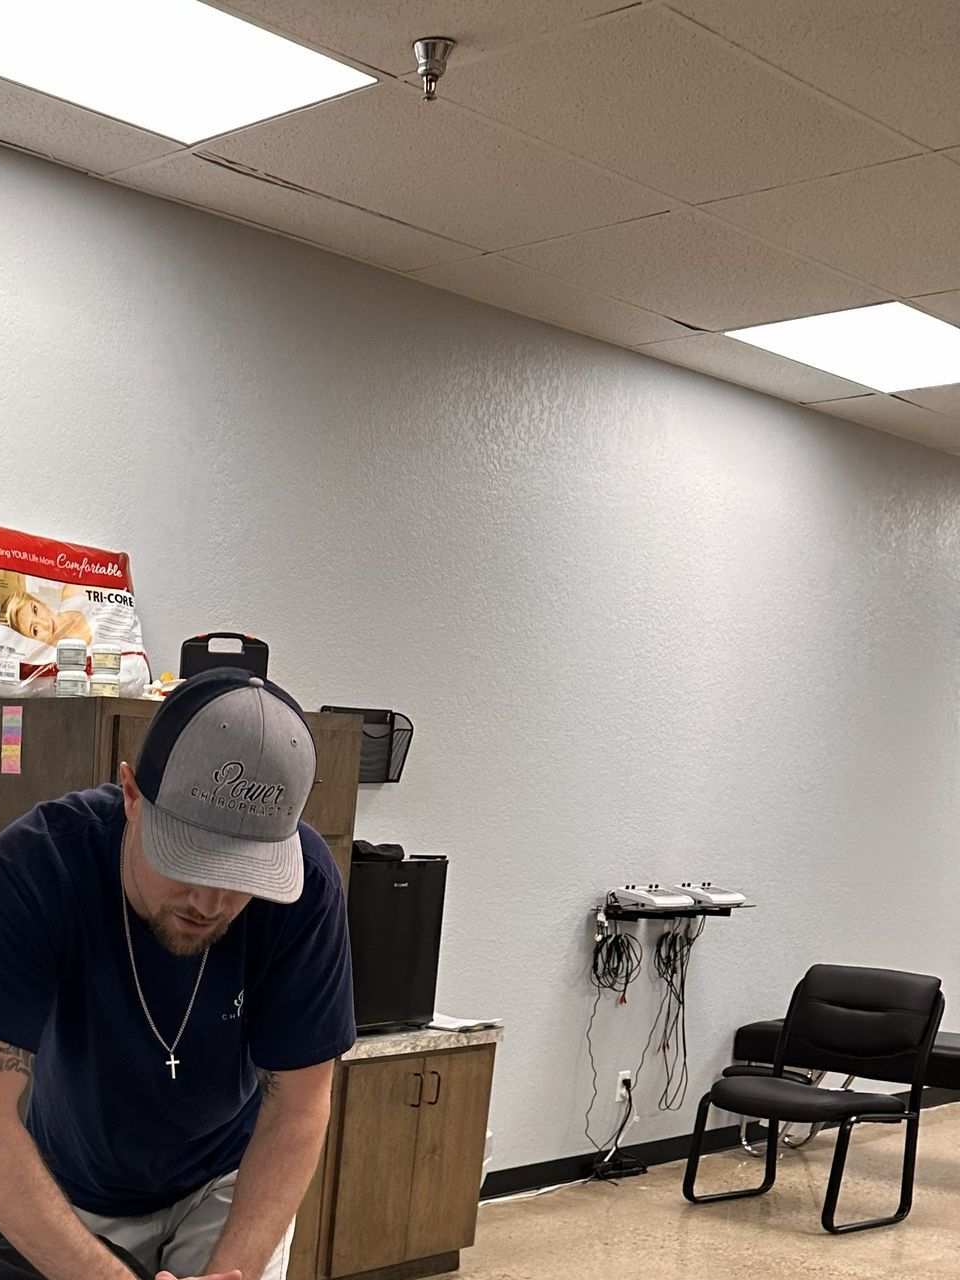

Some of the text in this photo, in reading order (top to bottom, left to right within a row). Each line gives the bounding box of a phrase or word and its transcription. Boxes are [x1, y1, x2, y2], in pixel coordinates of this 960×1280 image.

[11, 549, 28, 560] YOUR
[29, 553, 39, 563] Life
[40, 556, 55, 567] More
[56, 553, 123, 579] Comfortable
[85, 589, 135, 608] TRI-CORE
[213, 761, 285, 805] Power
[190, 786, 294, 817] CHIROPRACTC
